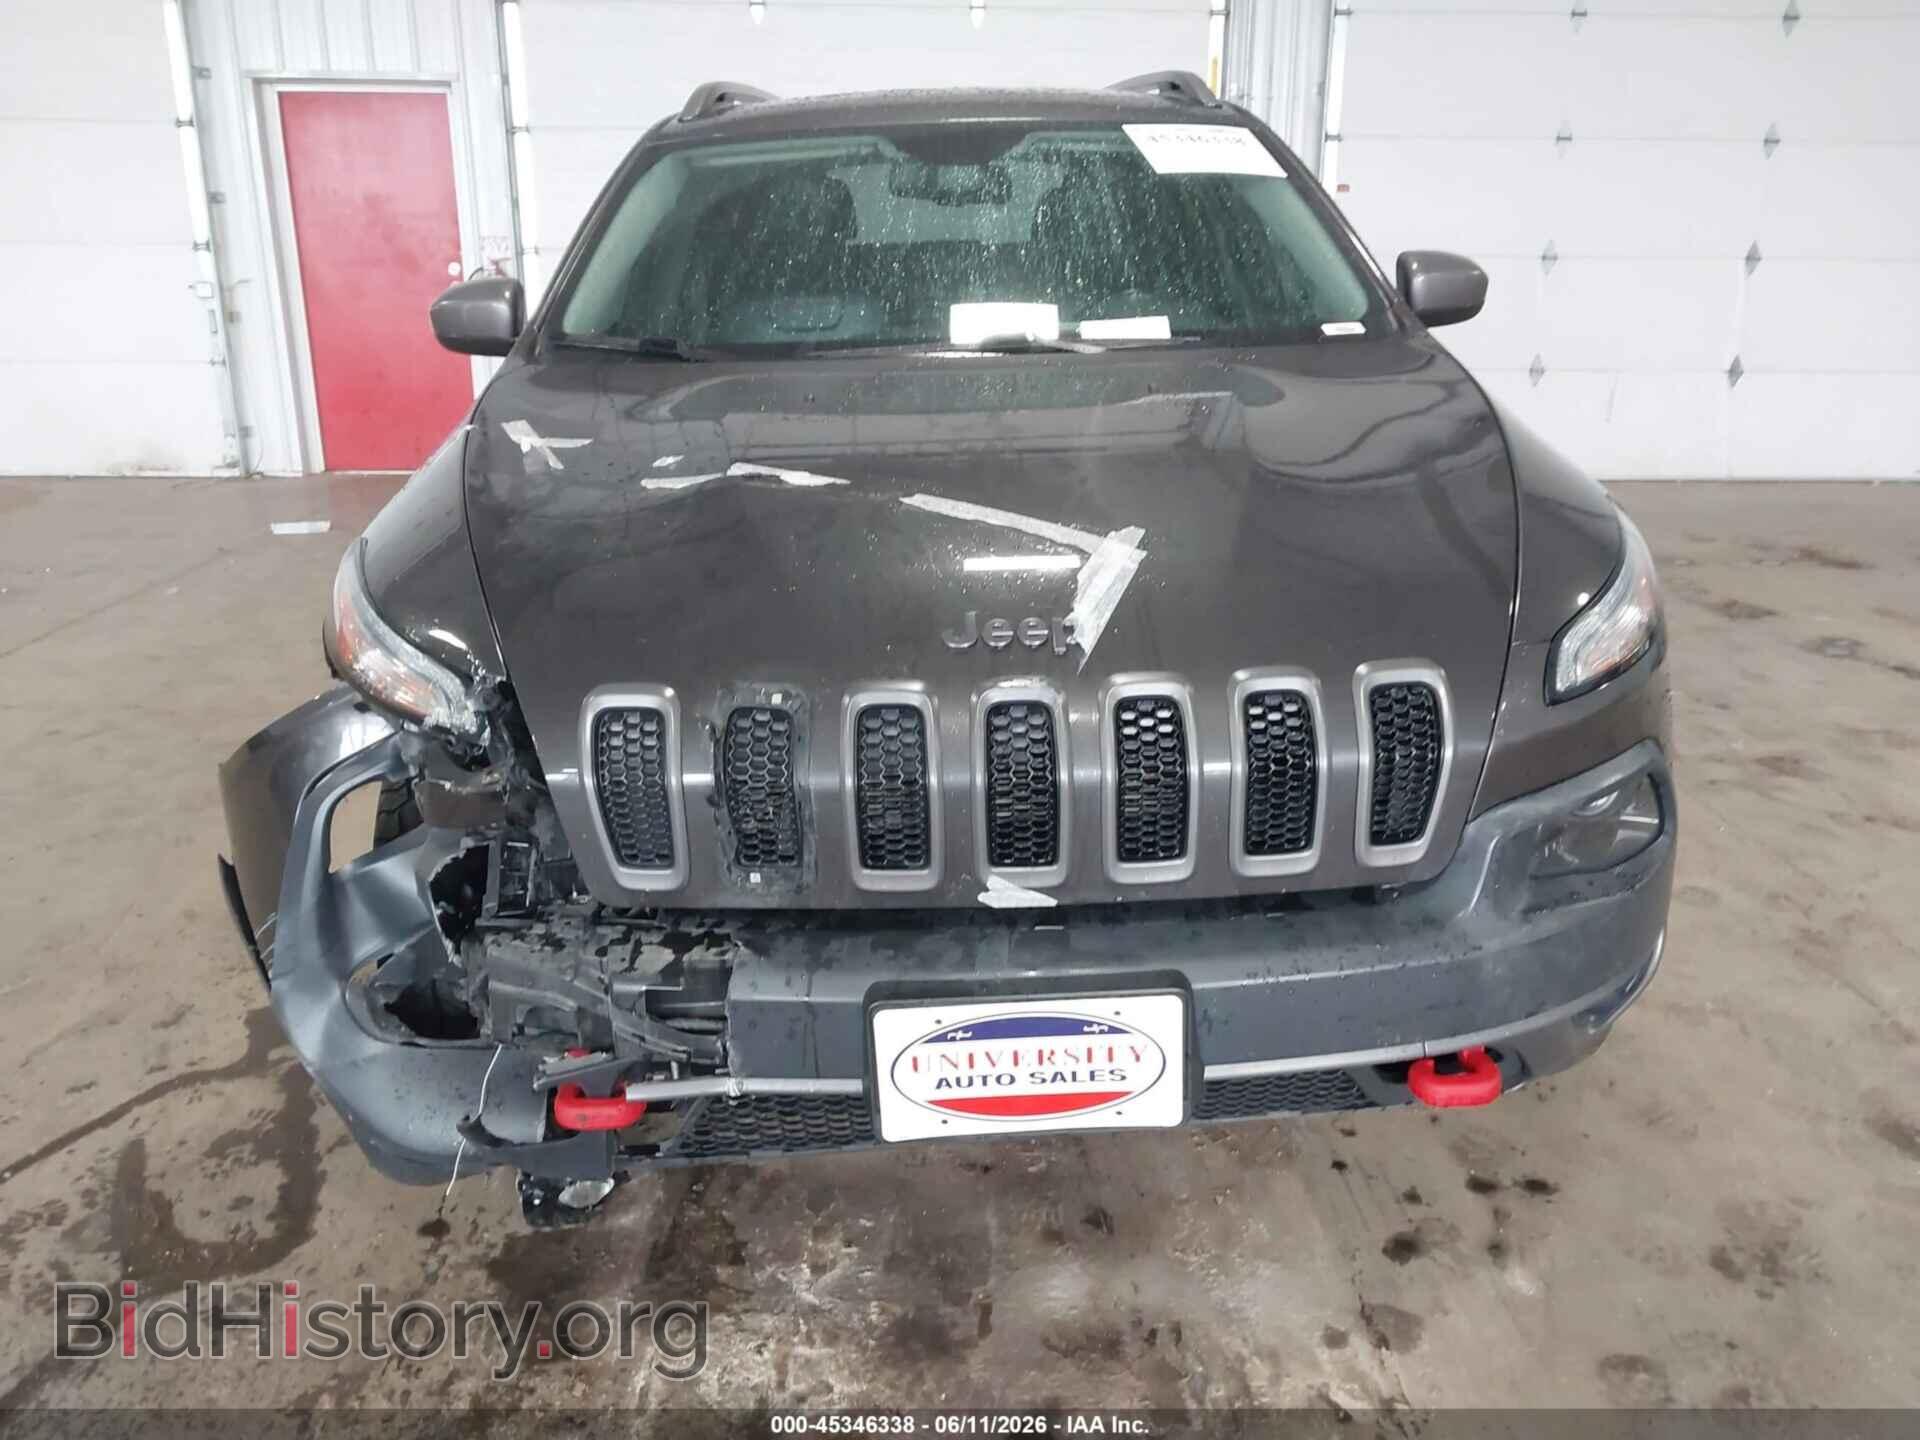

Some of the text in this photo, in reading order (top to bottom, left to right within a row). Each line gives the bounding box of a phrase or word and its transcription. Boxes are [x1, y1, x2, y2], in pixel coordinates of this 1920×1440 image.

[911, 1044, 1148, 1073] UNIVERSITY
[935, 1069, 1128, 1090] AUTO SALES
